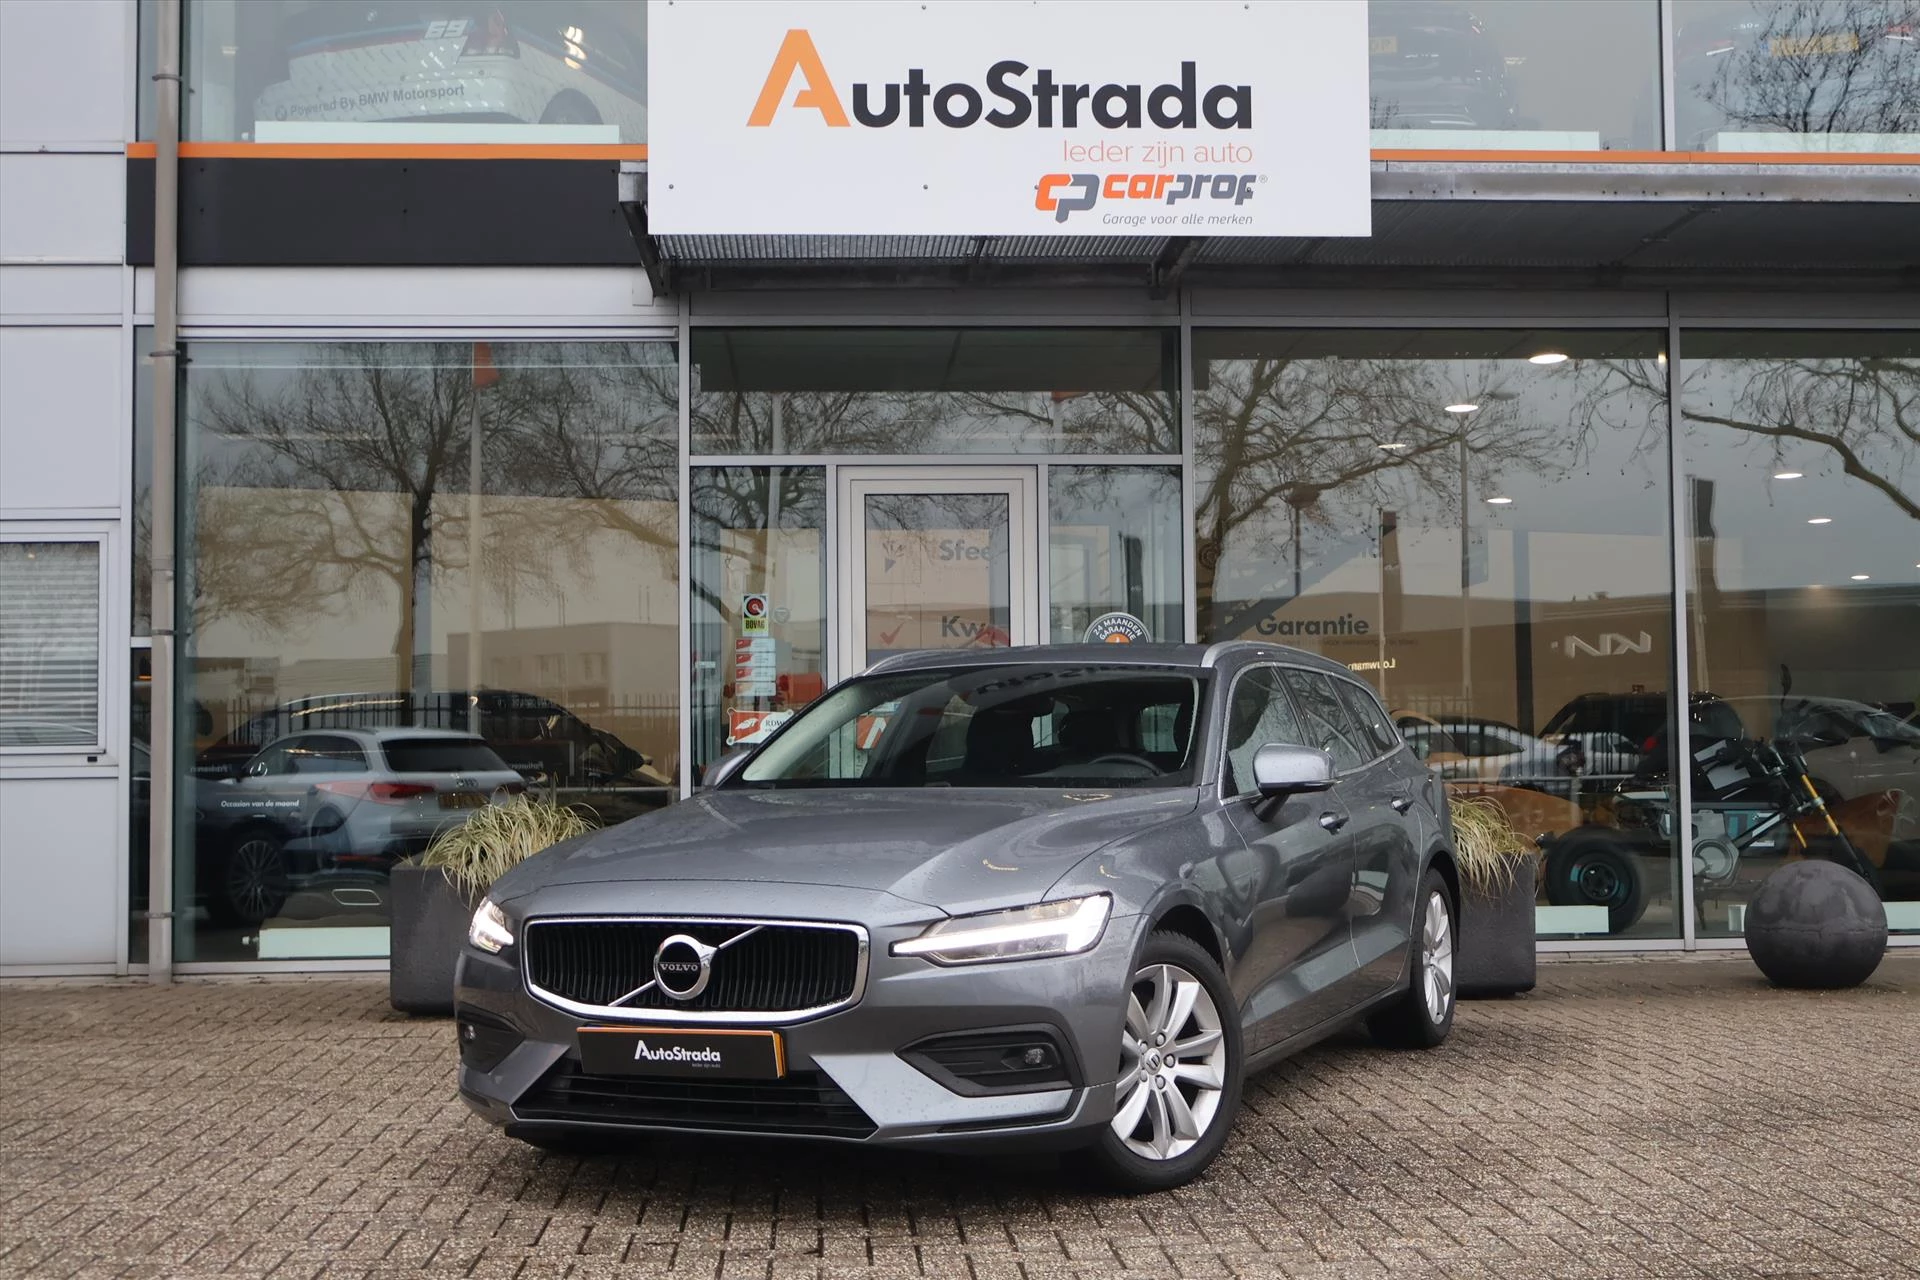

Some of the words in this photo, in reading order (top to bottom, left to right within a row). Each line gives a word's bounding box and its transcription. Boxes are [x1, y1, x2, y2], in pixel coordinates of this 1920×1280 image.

[425, 19, 469, 39] 69
[746, 29, 1253, 129] AutoStrada
[290, 98, 336, 115] Powered
[340, 97, 354, 110] By
[359, 91, 390, 105] BMW
[393, 84, 465, 102] Motorsport
[1064, 140, 1133, 162] Ieder
[1142, 141, 1184, 168] zijn
[1194, 143, 1253, 163] auto
[1103, 213, 1146, 227] Garage
[1151, 216, 1178, 225] voor
[1181, 213, 1204, 225] alle
[1208, 213, 1253, 225] merken
[1099, 625, 1137, 640] GARANTIE
[1104, 617, 1142, 636] MAANDEN
[1256, 613, 1369, 636] Garantie
[221, 800, 250, 808] Occasion
[660, 963, 698, 972] VOLVO
[634, 1040, 721, 1062] AutoStrada
